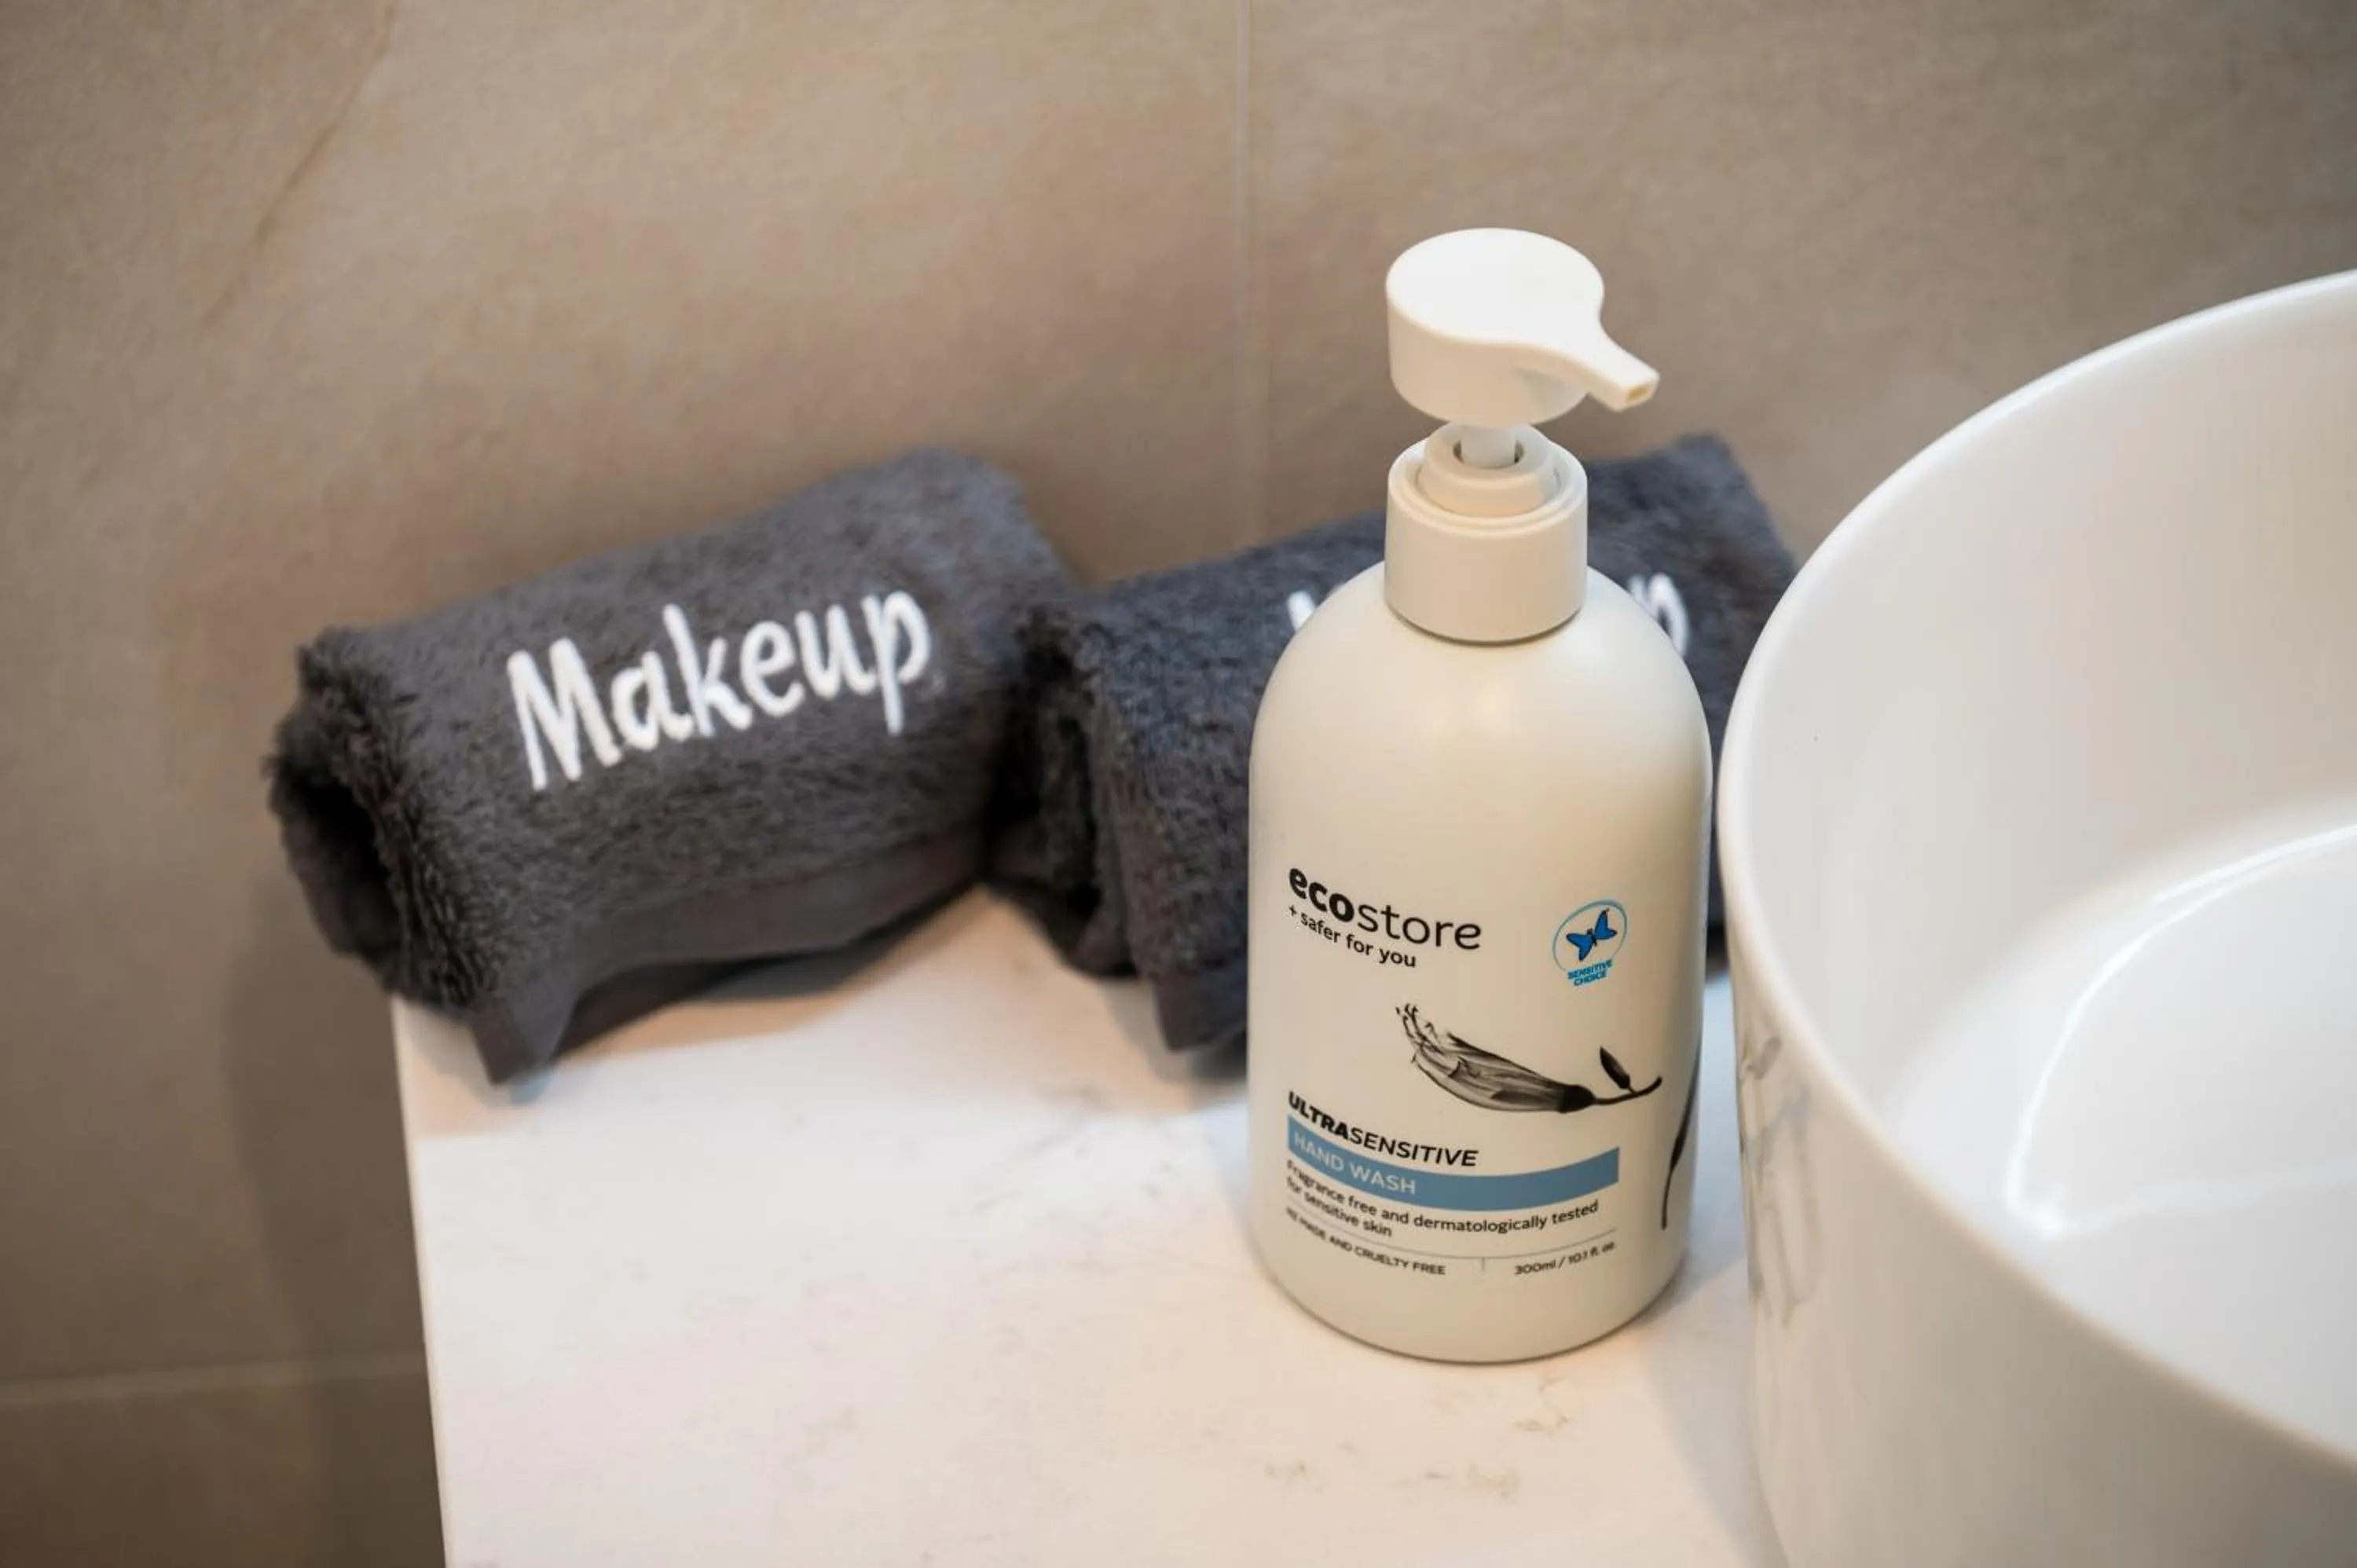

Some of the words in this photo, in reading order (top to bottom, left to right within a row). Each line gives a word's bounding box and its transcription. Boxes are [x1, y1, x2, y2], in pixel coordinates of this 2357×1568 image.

[507, 591, 932, 790] Makeup
[1288, 867, 1482, 950] ecostore
[1300, 912, 1341, 943] safer
[1346, 933, 1373, 956] for
[1379, 948, 1417, 968] you
[1567, 959, 1613, 980] SENSITIVE
[1574, 969, 1607, 986] CHOICE
[1288, 1090, 1479, 1167] ULTRASENSITIVE
[1294, 1131, 1344, 1172] HAND
[1349, 1163, 1417, 1194] WASH
[1287, 1160, 1345, 1203] Fragrance
[1348, 1196, 1377, 1216] free
[1381, 1209, 1409, 1225] and
[1414, 1215, 1548, 1234] dermatologically
[1552, 1200, 1599, 1224] tested
[1287, 1175, 1301, 1195] for
[1304, 1192, 1359, 1227] sensitive
[1363, 1219, 1392, 1237] skin
[1330, 1236, 1352, 1251] AND
[1354, 1246, 1409, 1269] CRUELTY
[1413, 1260, 1446, 1276] FREE
[1515, 1260, 1556, 1275] 300ml
